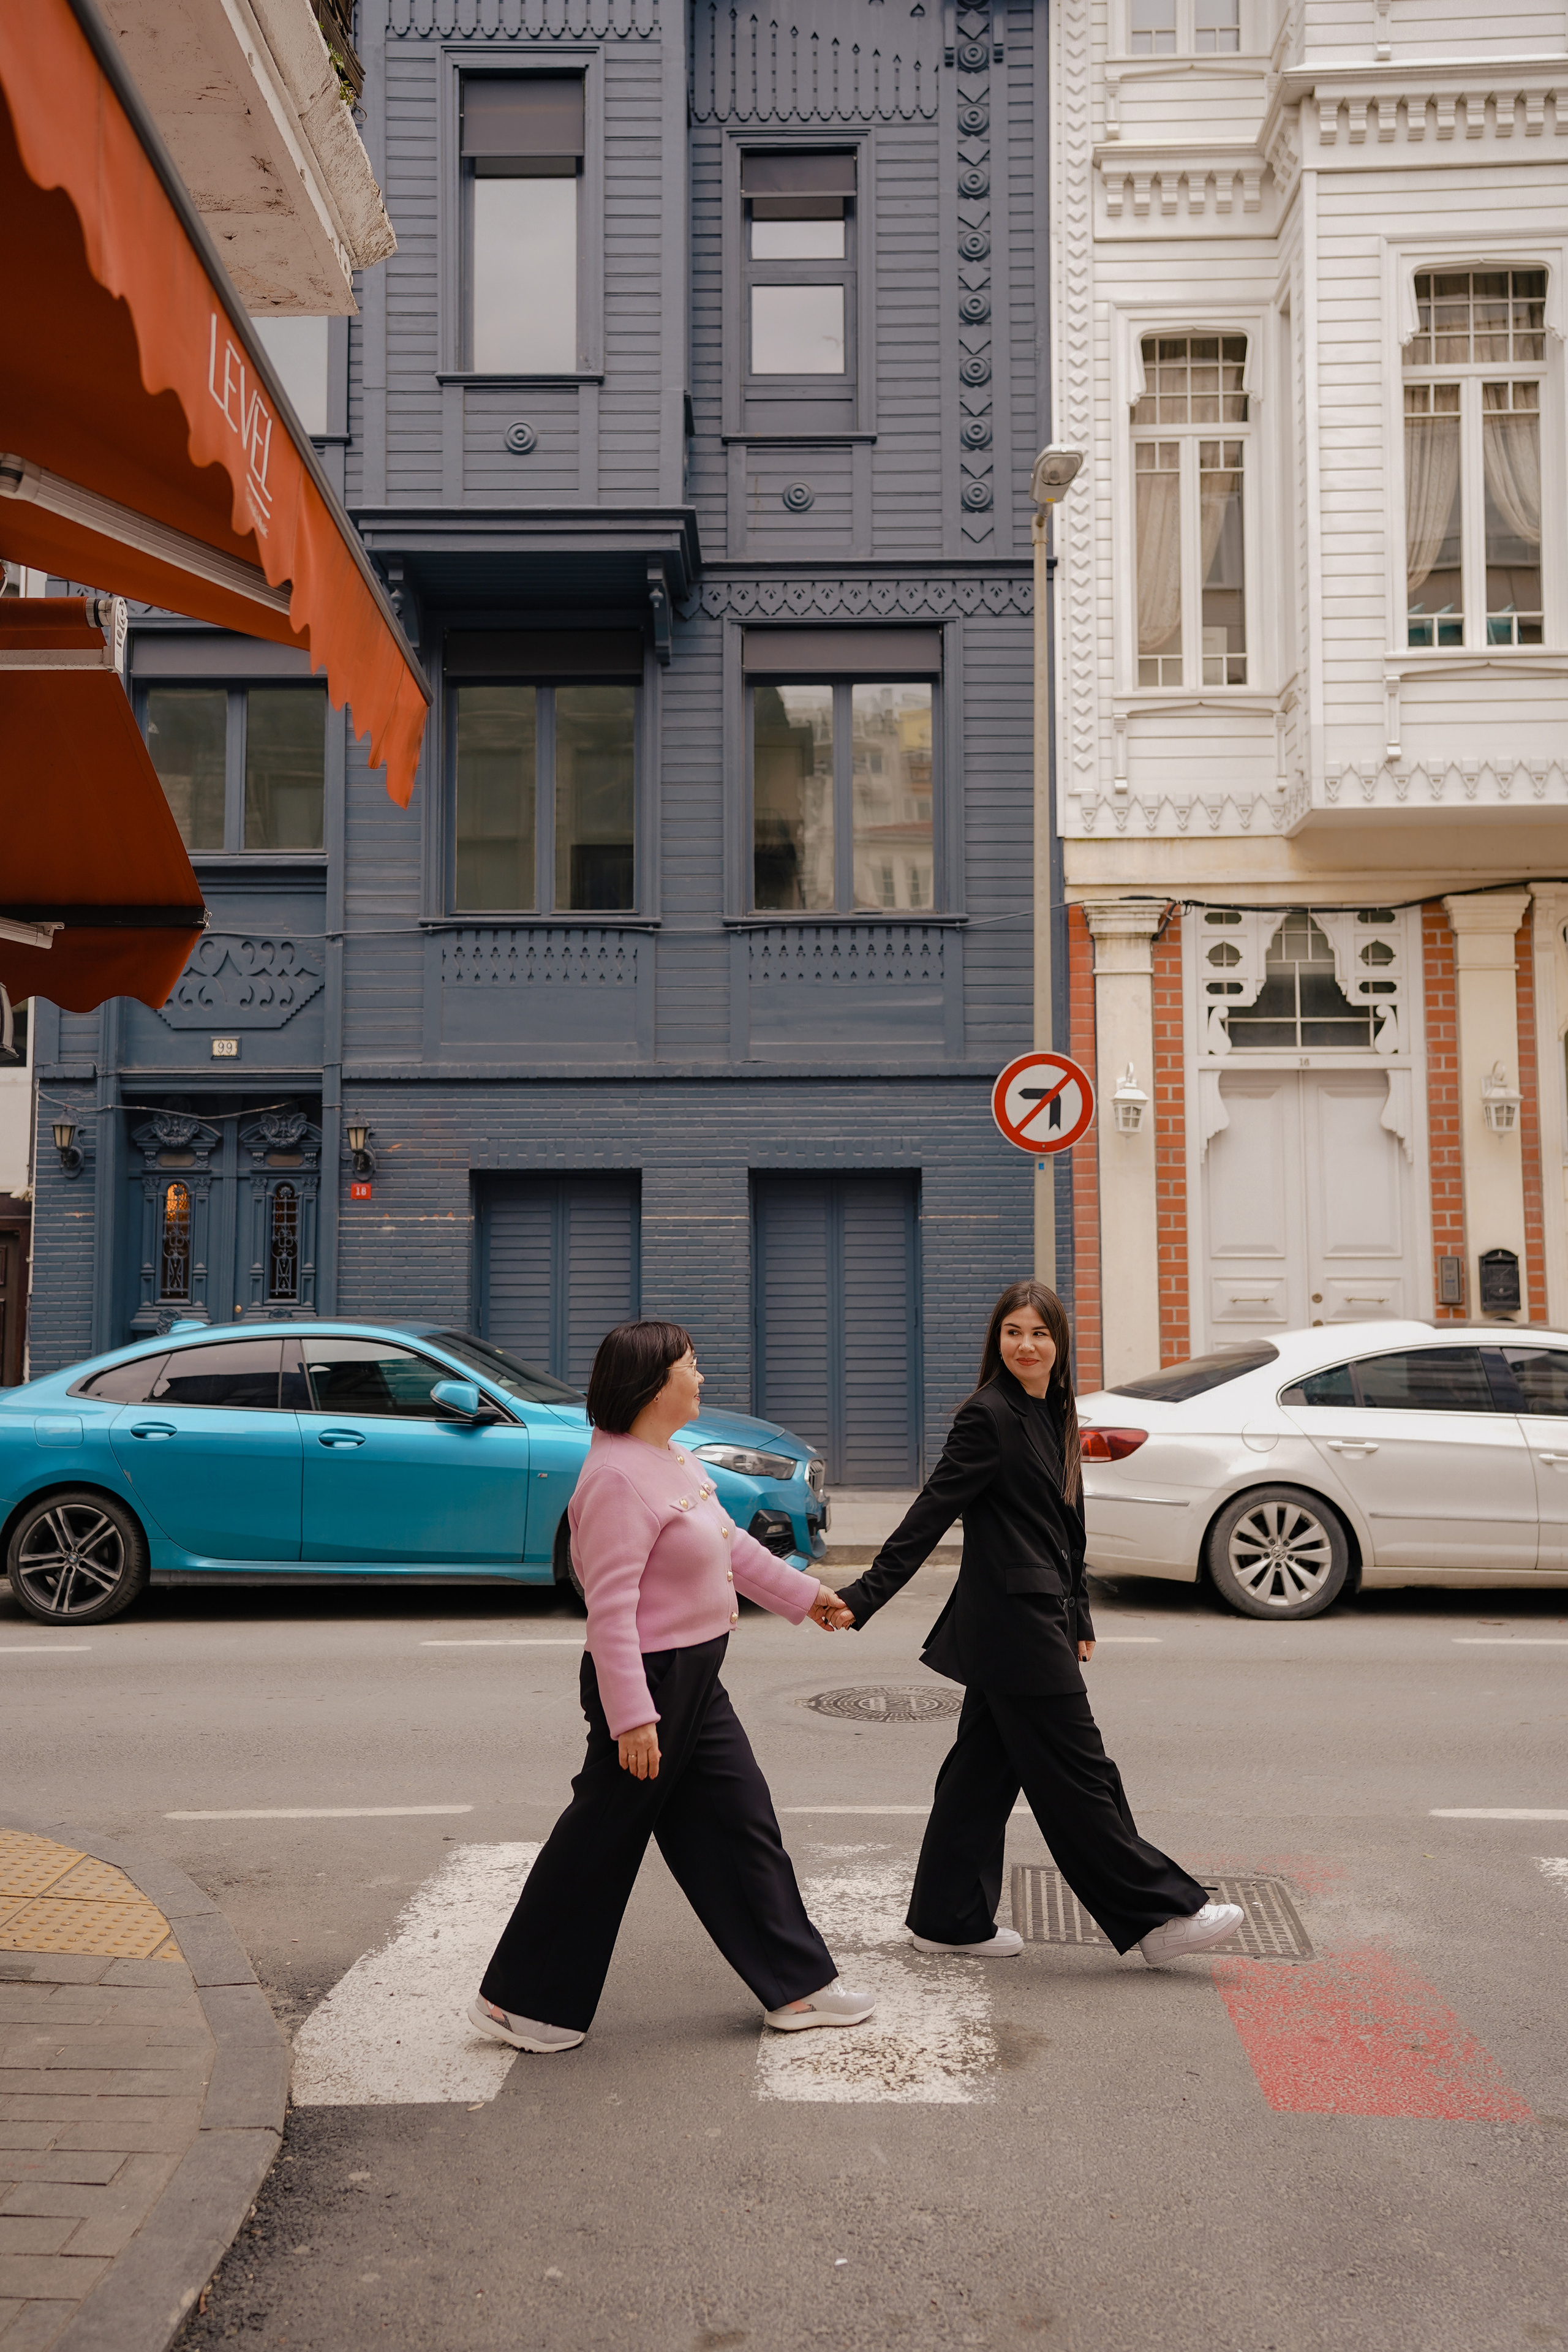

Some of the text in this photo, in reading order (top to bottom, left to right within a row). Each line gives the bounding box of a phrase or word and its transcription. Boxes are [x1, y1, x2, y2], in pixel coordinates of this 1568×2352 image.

[209, 312, 272, 502] LEVEL
[218, 1041, 232, 1054] 99
[356, 1186, 366, 1196] 18
